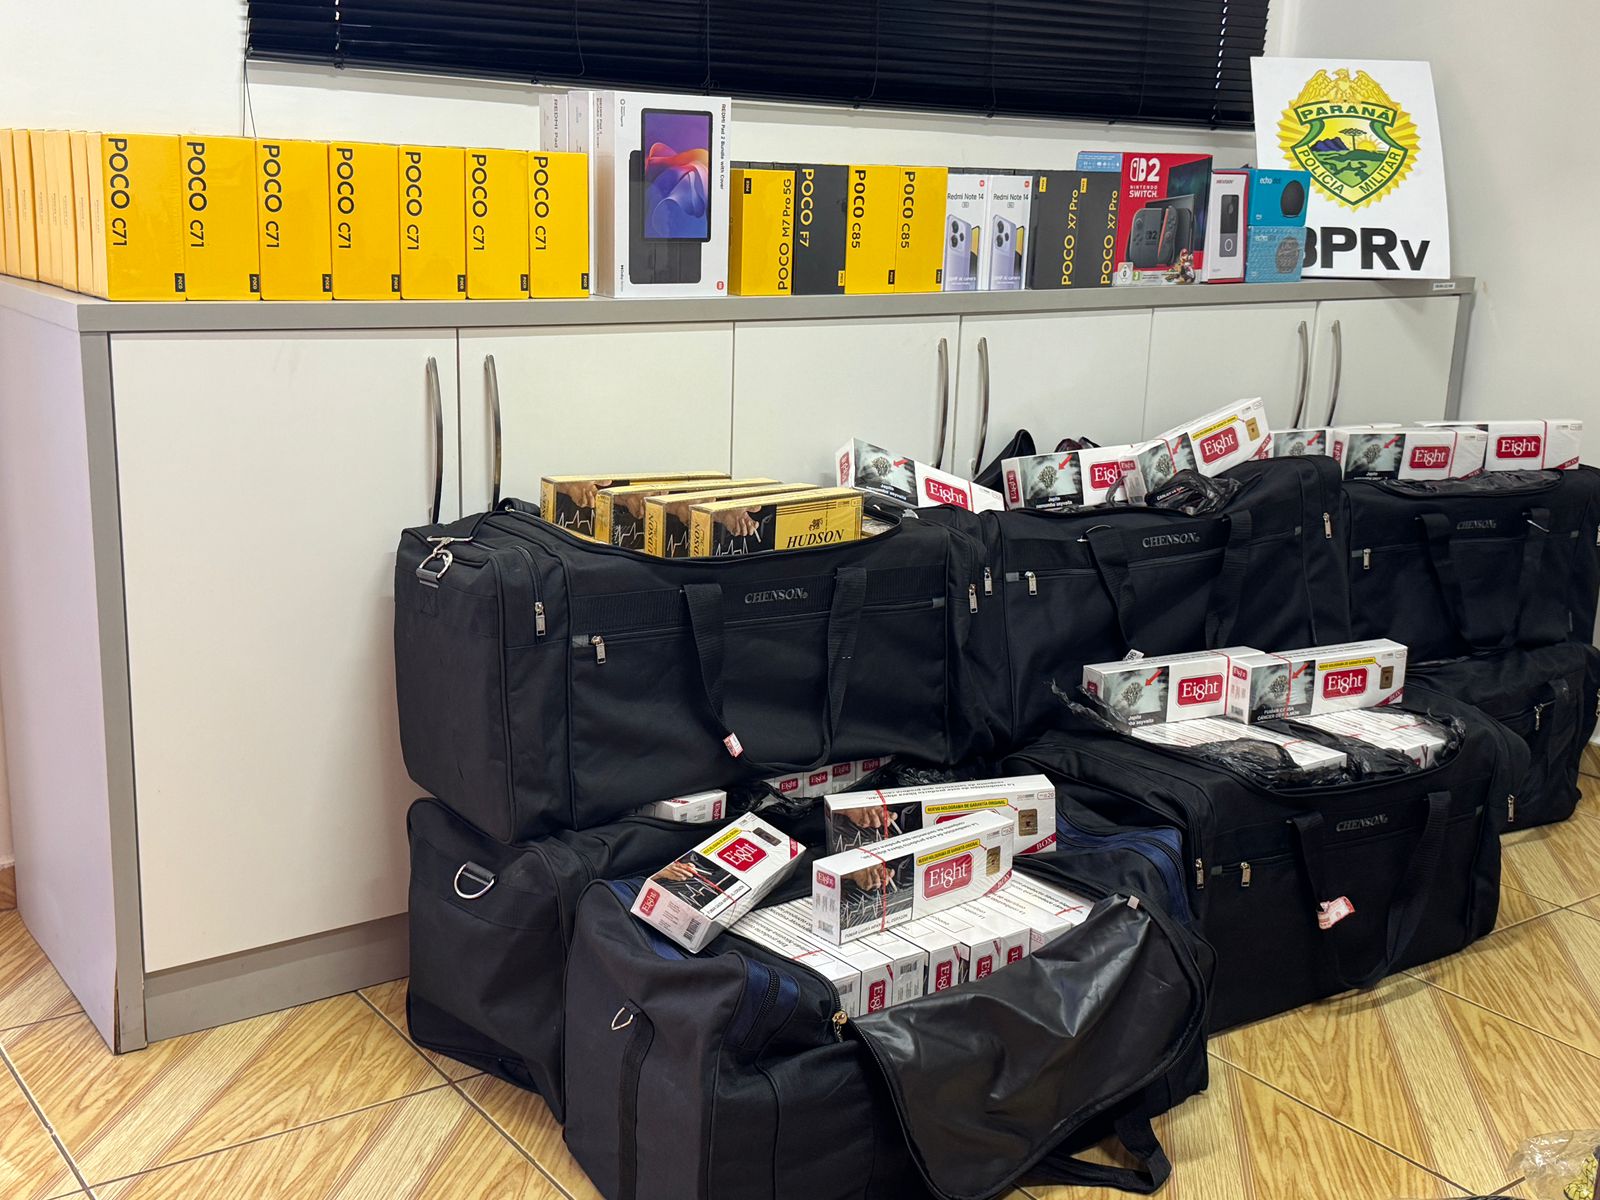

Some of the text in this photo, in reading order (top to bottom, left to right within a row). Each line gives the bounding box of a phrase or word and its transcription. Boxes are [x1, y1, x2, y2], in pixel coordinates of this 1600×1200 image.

[1301, 105, 1391, 122] PARANÁ
[1260, 176, 1272, 184] echo
[1359, 152, 1401, 194] MILITAR
[108, 138, 130, 246] POCO C71
[187, 142, 208, 247] POCO C71
[263, 145, 283, 248] POCO C71
[336, 148, 355, 249] POCO C71
[405, 151, 423, 250] POCO C71
[471, 154, 488, 250] POCO C71
[533, 156, 550, 250] POCO C71
[1129, 190, 1157, 198] SWITCH
[799, 168, 815, 248] POCO F7
[851, 169, 867, 249] POCO C85
[900, 171, 916, 249] POCO C85
[778, 178, 792, 290] POCO M7 Pro 5G
[1062, 189, 1079, 285] POCO X7 Pro
[1101, 190, 1118, 285] POCO X7 Pro
[1203, 431, 1235, 455] Eight
[1500, 439, 1537, 456] Eight
[1415, 449, 1446, 467] Eight
[1094, 465, 1120, 485] Eigh
[929, 481, 964, 505] Eight
[787, 529, 844, 548] HUDSON
[1142, 532, 1196, 548] CHENSON
[744, 588, 804, 604] CHENSON
[1182, 679, 1219, 700] Eight
[1327, 673, 1362, 693] Eight
[1336, 815, 1385, 832] CHENSON
[723, 838, 757, 866] Eight
[1036, 835, 1053, 850] BOX
[929, 862, 968, 888] Eight
[642, 891, 657, 912] Eight
[936, 966, 950, 990] Eig
[870, 984, 884, 1009] Eig
